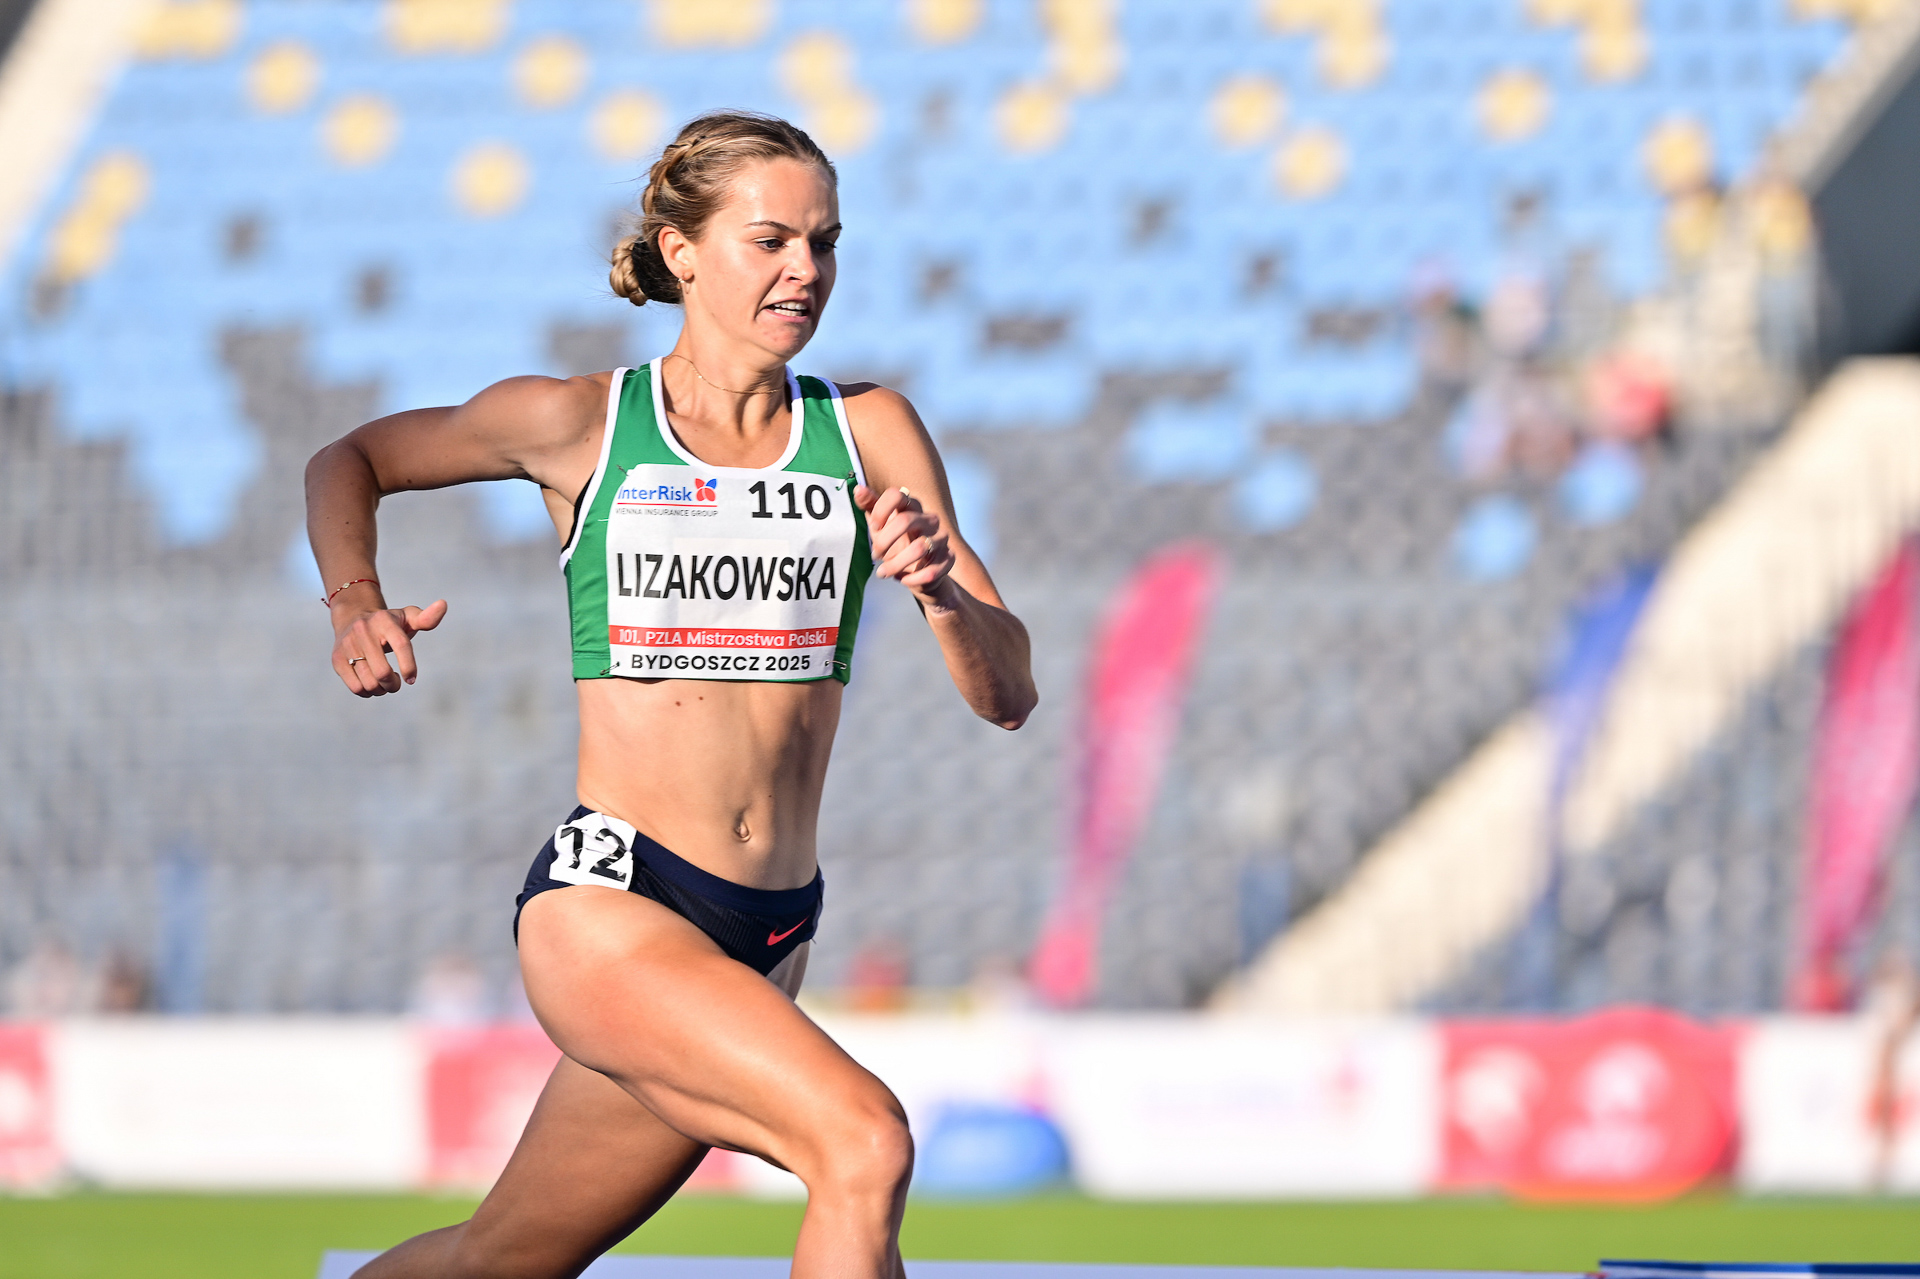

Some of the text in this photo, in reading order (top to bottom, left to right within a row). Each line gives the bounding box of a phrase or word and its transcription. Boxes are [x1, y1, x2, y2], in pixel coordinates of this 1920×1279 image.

[617, 485, 693, 502] InterRisk
[749, 480, 832, 520] 110
[616, 508, 719, 518] VIENNA INSURANCE GROUP
[616, 553, 836, 601] LIZAKOWSKA
[618, 629, 828, 647] 101. PZLA Mistrzostwa Polski
[631, 654, 811, 671] BYDGOSZCZ 2025
[560, 826, 626, 883] 12
